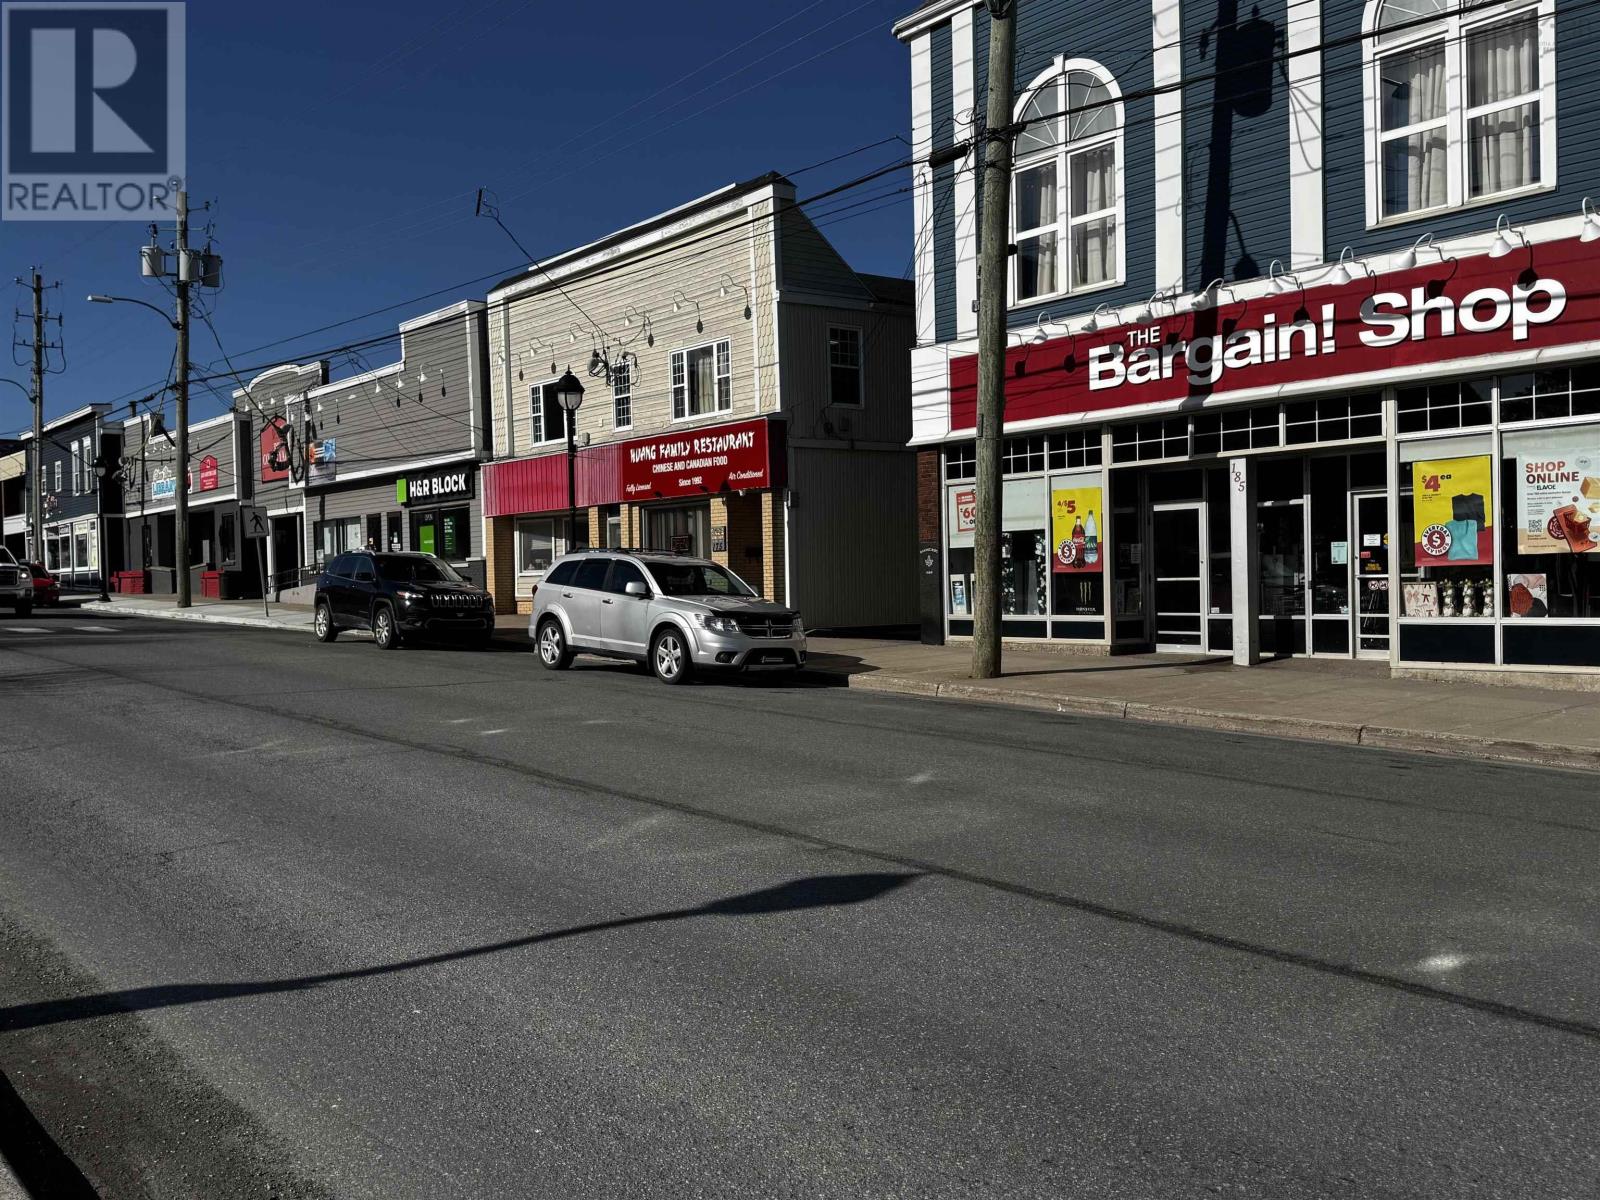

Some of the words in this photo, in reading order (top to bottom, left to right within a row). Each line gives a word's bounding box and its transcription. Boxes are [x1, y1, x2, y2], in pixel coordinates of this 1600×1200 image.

[1088, 303, 1336, 390] Bargain!
[1359, 278, 1567, 347] Shop
[1127, 325, 1161, 347] THE
[630, 444, 656, 463] HUANG
[659, 440, 690, 459] FAMILY
[693, 431, 755, 454] RESTAURANT
[652, 462, 674, 474] CHINESE
[674, 460, 686, 471] AND
[686, 457, 712, 470] CANADIAN
[713, 455, 728, 466] FOOD
[1526, 461, 1566, 474] SHOP
[728, 471, 737, 480] Air
[736, 468, 764, 479] Conditioned
[1526, 471, 1580, 485] ONLINE
[409, 480, 430, 498] H&R
[432, 473, 467, 495] BLOCK
[678, 478, 692, 487] Since
[1421, 474, 1441, 492] $4
[1423, 525, 1450, 538] EVERYDAY
[1424, 542, 1450, 555] SAVINGS
